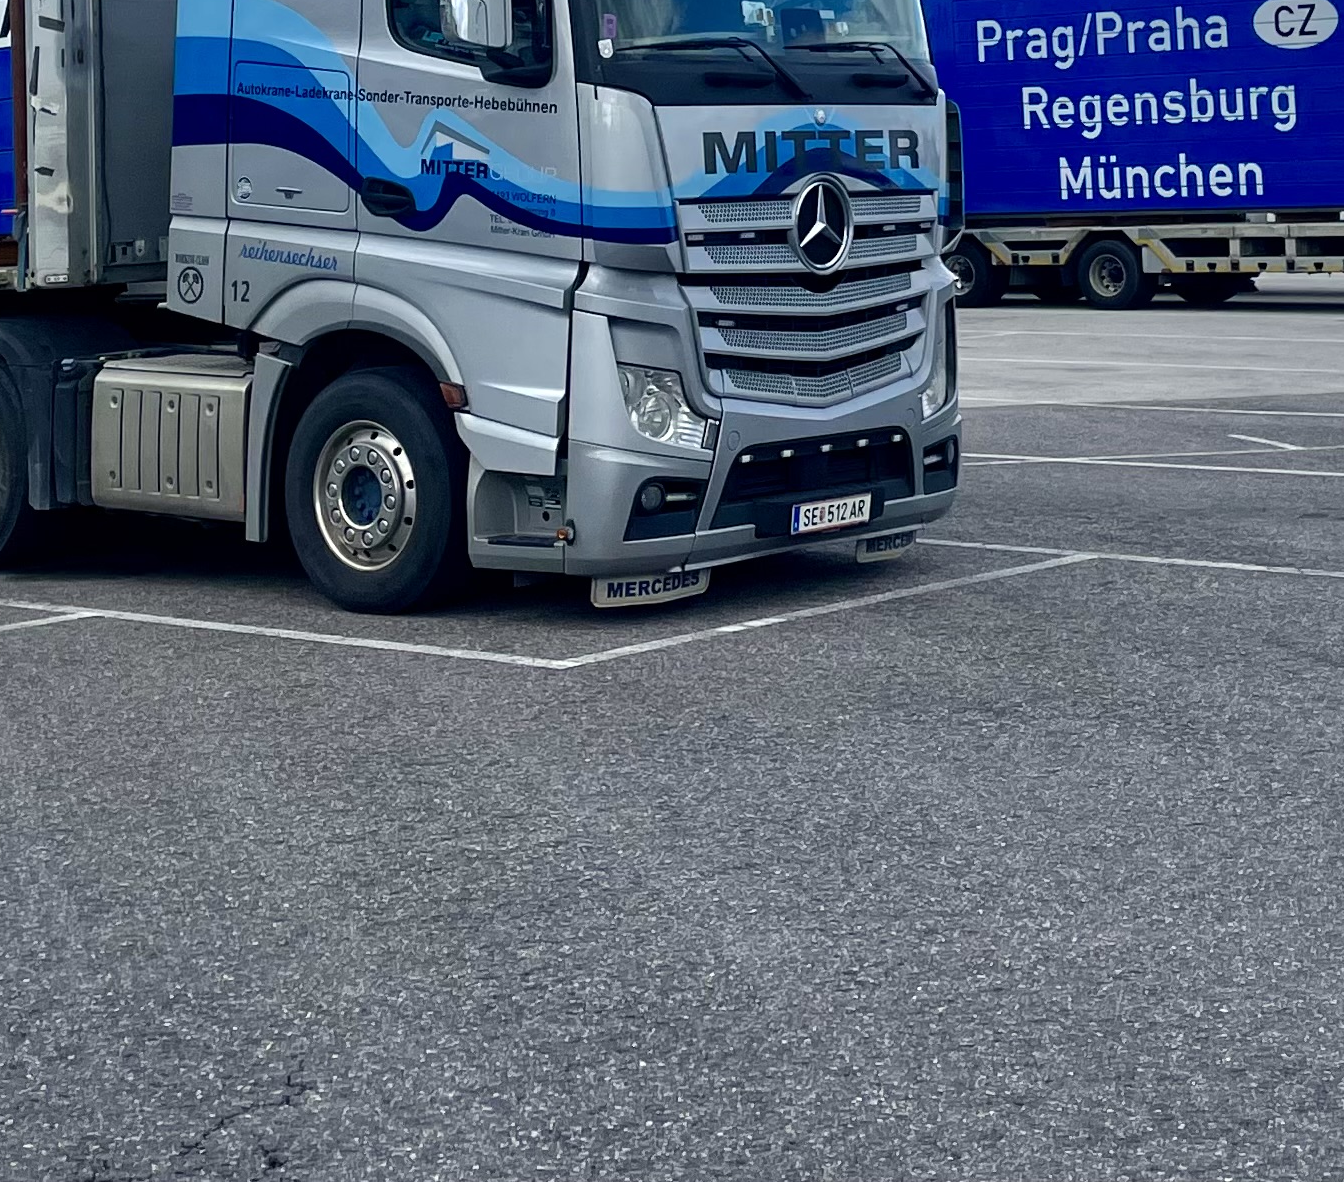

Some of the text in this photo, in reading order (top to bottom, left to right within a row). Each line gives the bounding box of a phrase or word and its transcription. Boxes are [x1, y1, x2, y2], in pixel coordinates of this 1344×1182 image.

[976, 4, 1318, 70] Prag/Praha CZ
[236, 82, 558, 114] Autokrane-Ladekrane-Sonder-Transporte-Hebebühnen
[1022, 78, 1297, 139] Regensburg
[703, 129, 920, 175] MITTER
[421, 158, 488, 179] MITTER
[1059, 151, 1264, 201] München
[512, 194, 557, 204] WOLFERN
[239, 239, 338, 271] reihensechser
[231, 280, 250, 302] 12
[803, 498, 865, 527] SE 512 AR
[607, 572, 700, 599] MERCEDES
